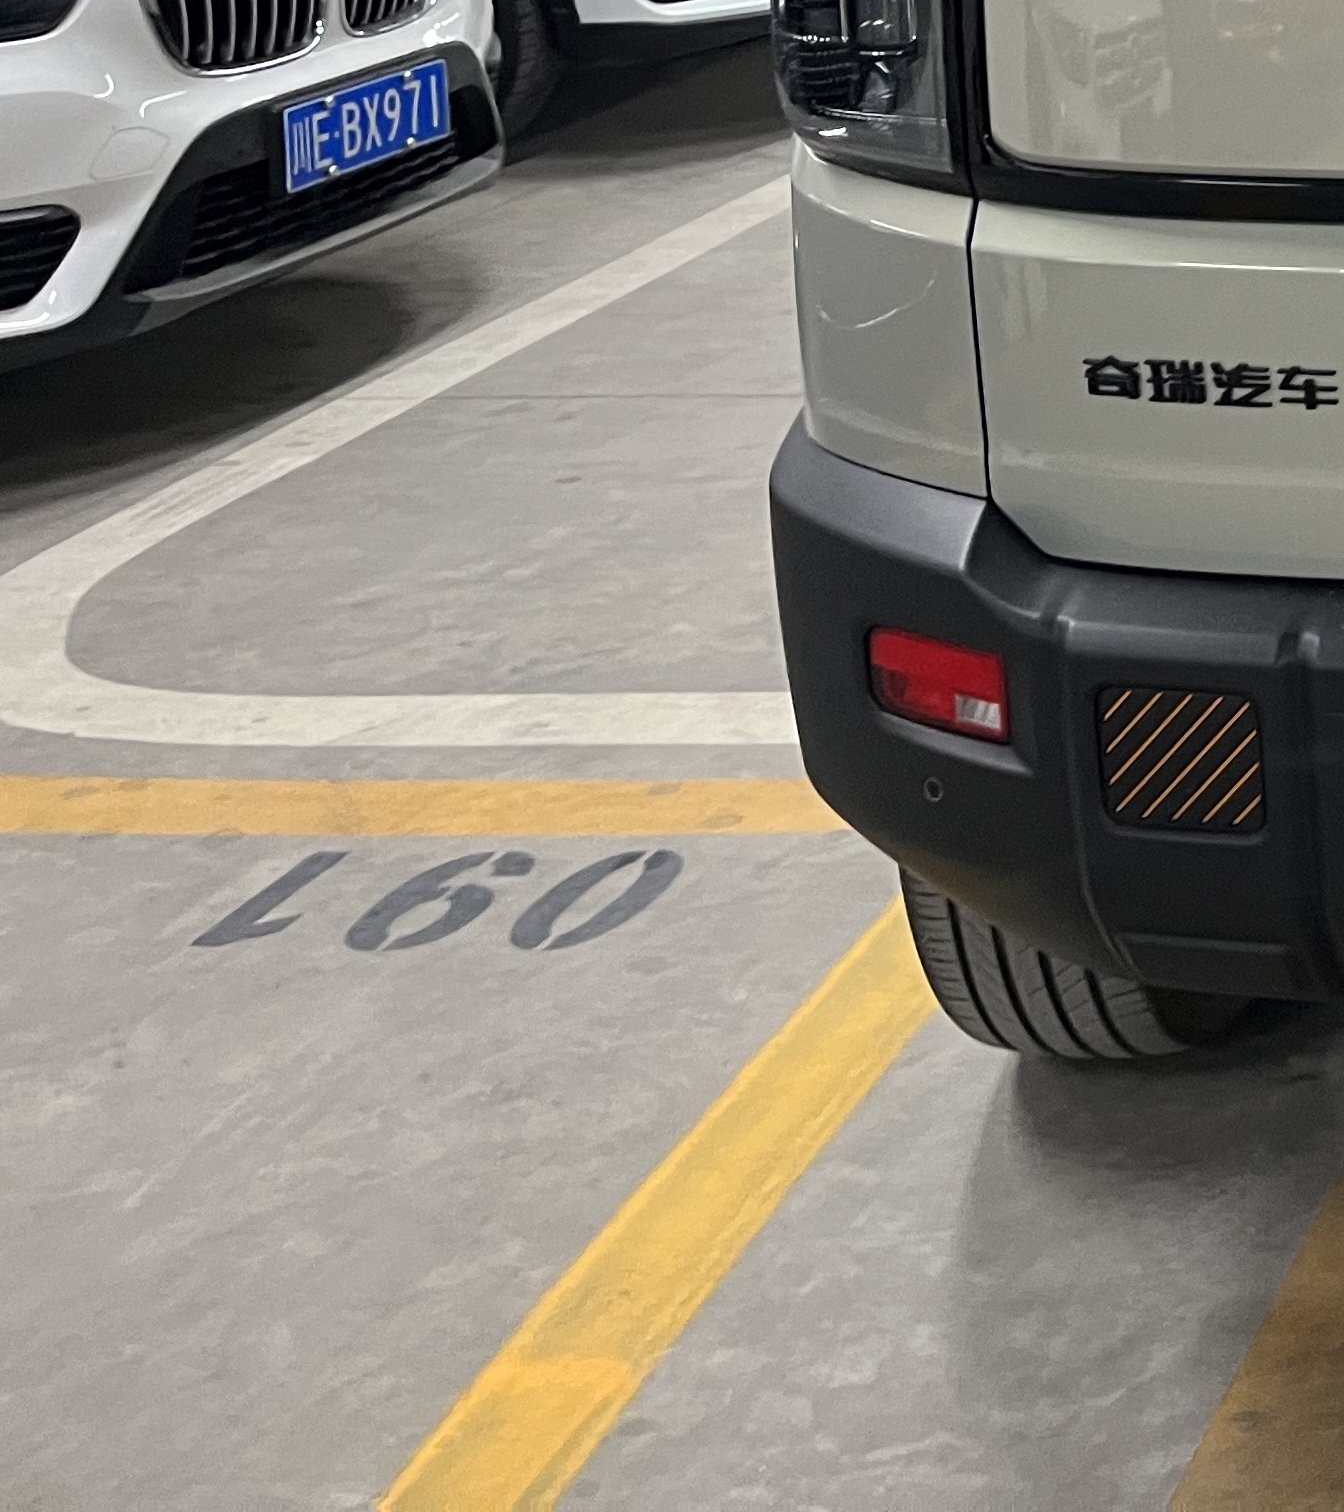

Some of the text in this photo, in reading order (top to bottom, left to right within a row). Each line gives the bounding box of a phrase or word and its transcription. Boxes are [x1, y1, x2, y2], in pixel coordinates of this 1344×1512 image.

[1082, 355, 1340, 410] 奇瑞汽车
[191, 849, 684, 951] 091
